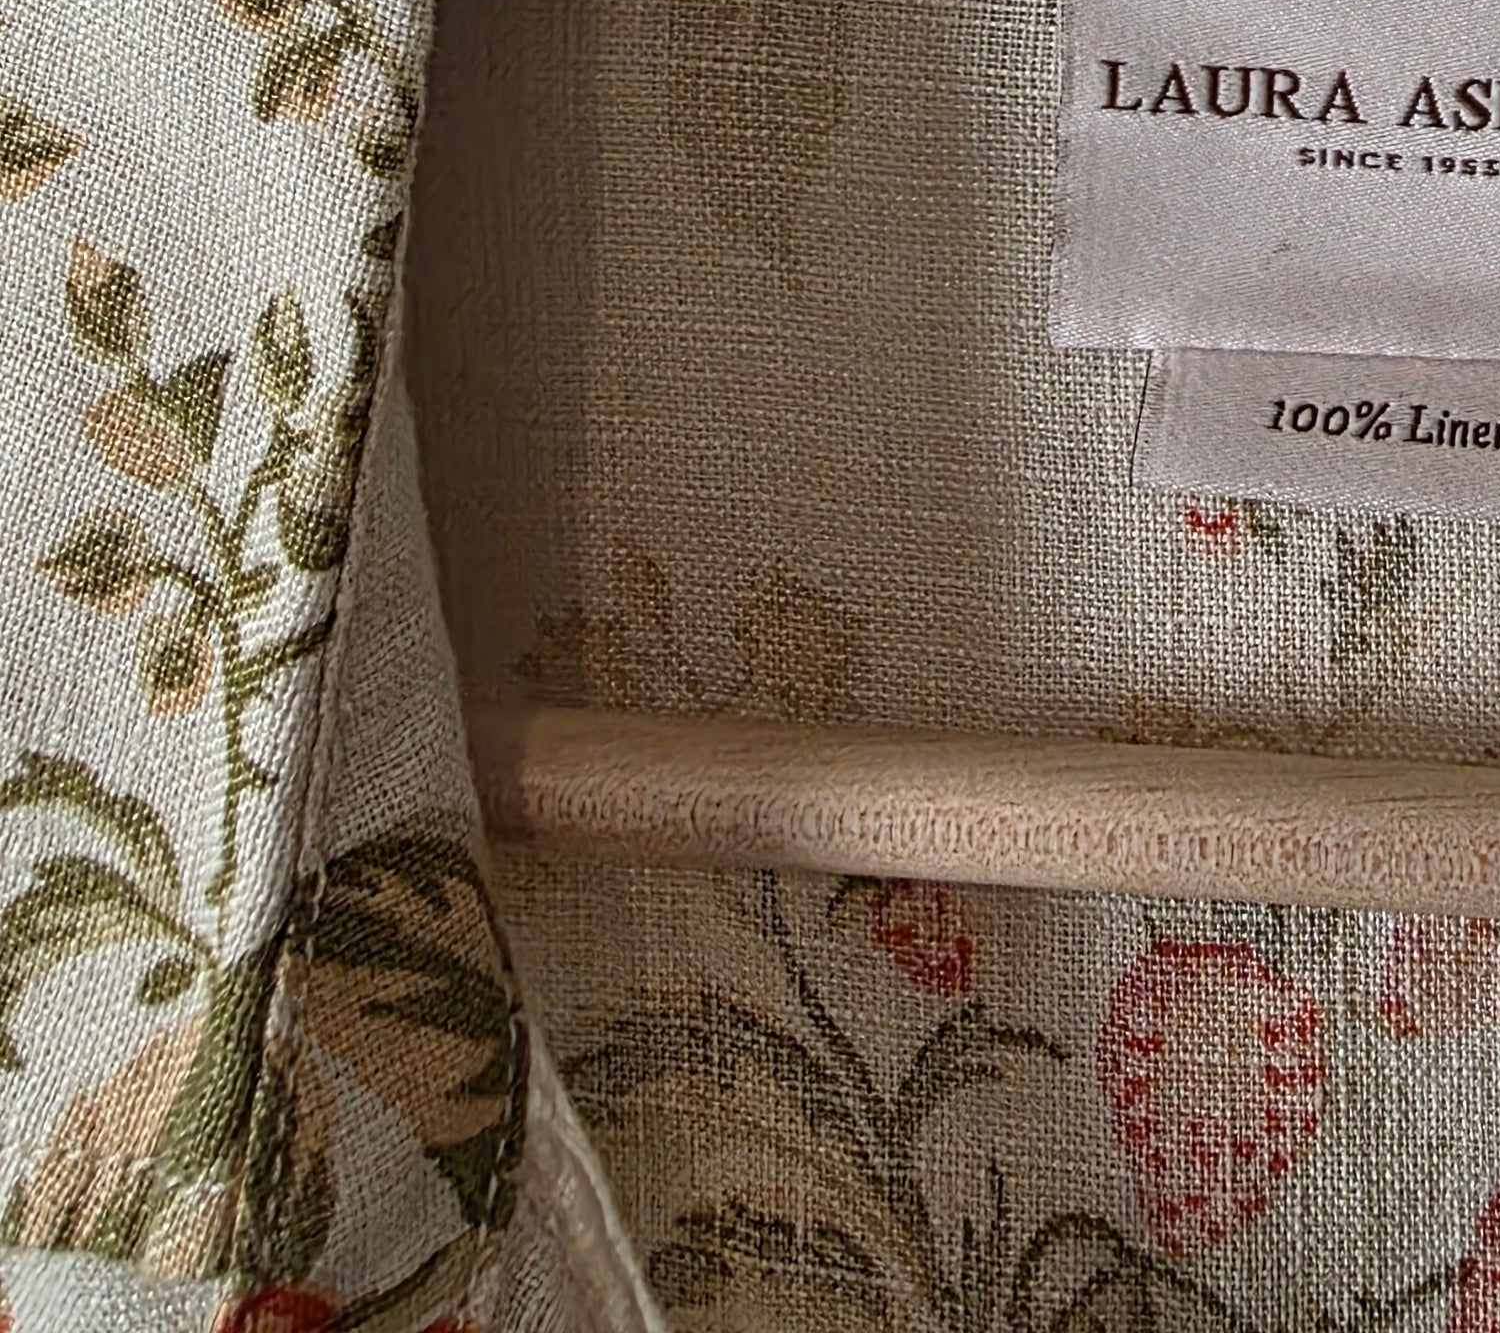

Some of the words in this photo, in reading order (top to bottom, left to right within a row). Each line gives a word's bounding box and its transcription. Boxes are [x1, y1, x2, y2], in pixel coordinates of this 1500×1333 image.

[1098, 59, 1368, 127] LAURA
[1296, 145, 1403, 171] SINCE
[1265, 399, 1392, 443] 100%
